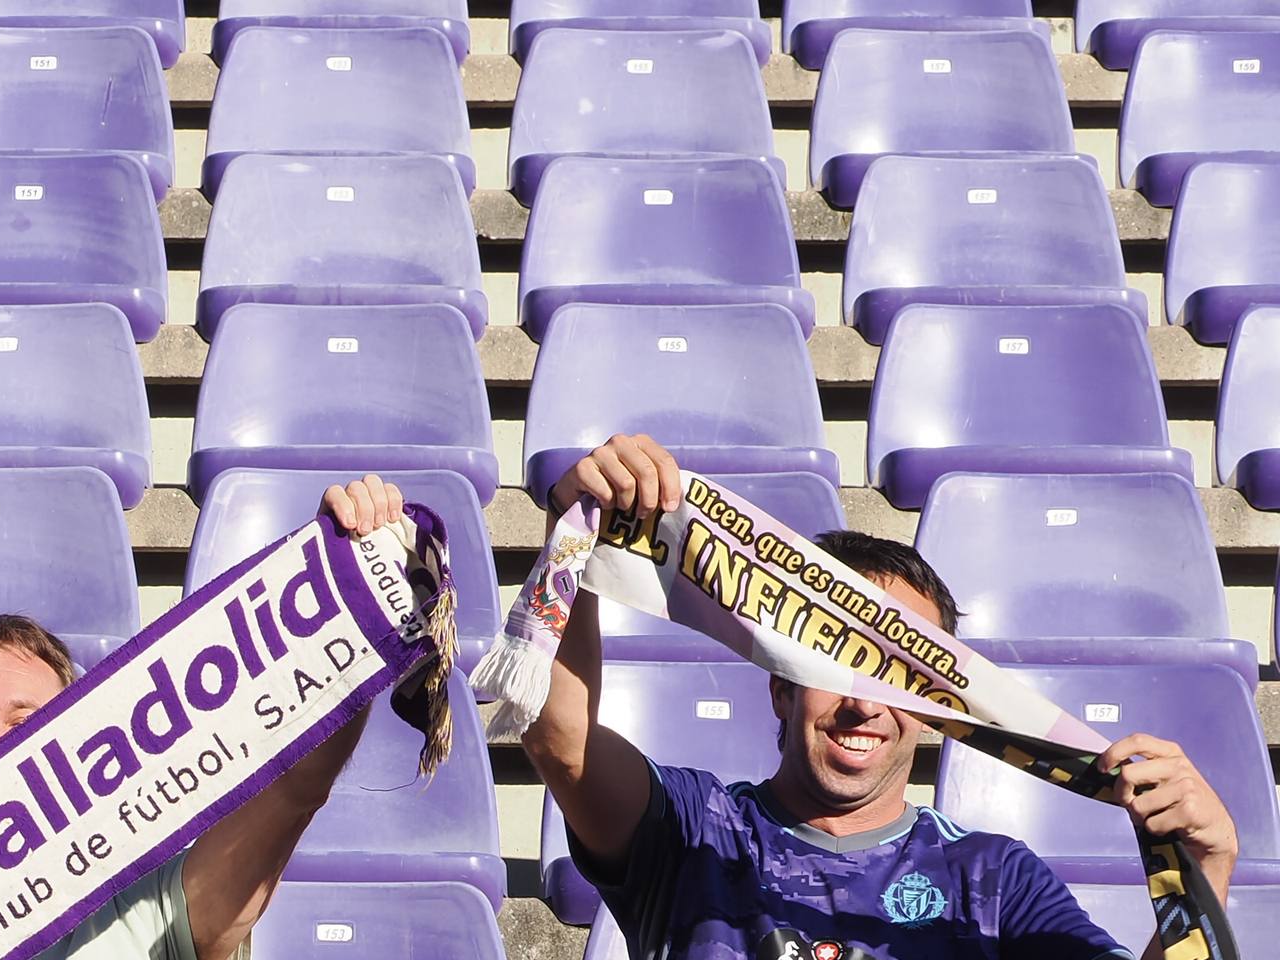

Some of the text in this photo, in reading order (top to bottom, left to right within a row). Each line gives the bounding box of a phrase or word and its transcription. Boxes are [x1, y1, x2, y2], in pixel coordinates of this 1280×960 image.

[22, 189, 37, 197] 151
[336, 342, 352, 350] 153
[665, 342, 681, 350] 155
[1006, 343, 1022, 351] 157
[686, 478, 969, 689] Dicen, que es una locura...
[704, 706, 723, 714] 155
[1094, 708, 1112, 717] 157
[65, 832, 113, 877] de
[118, 733, 250, 835] fútbol,
[253, 637, 368, 730] S.A.D.
[326, 929, 345, 939] 153
